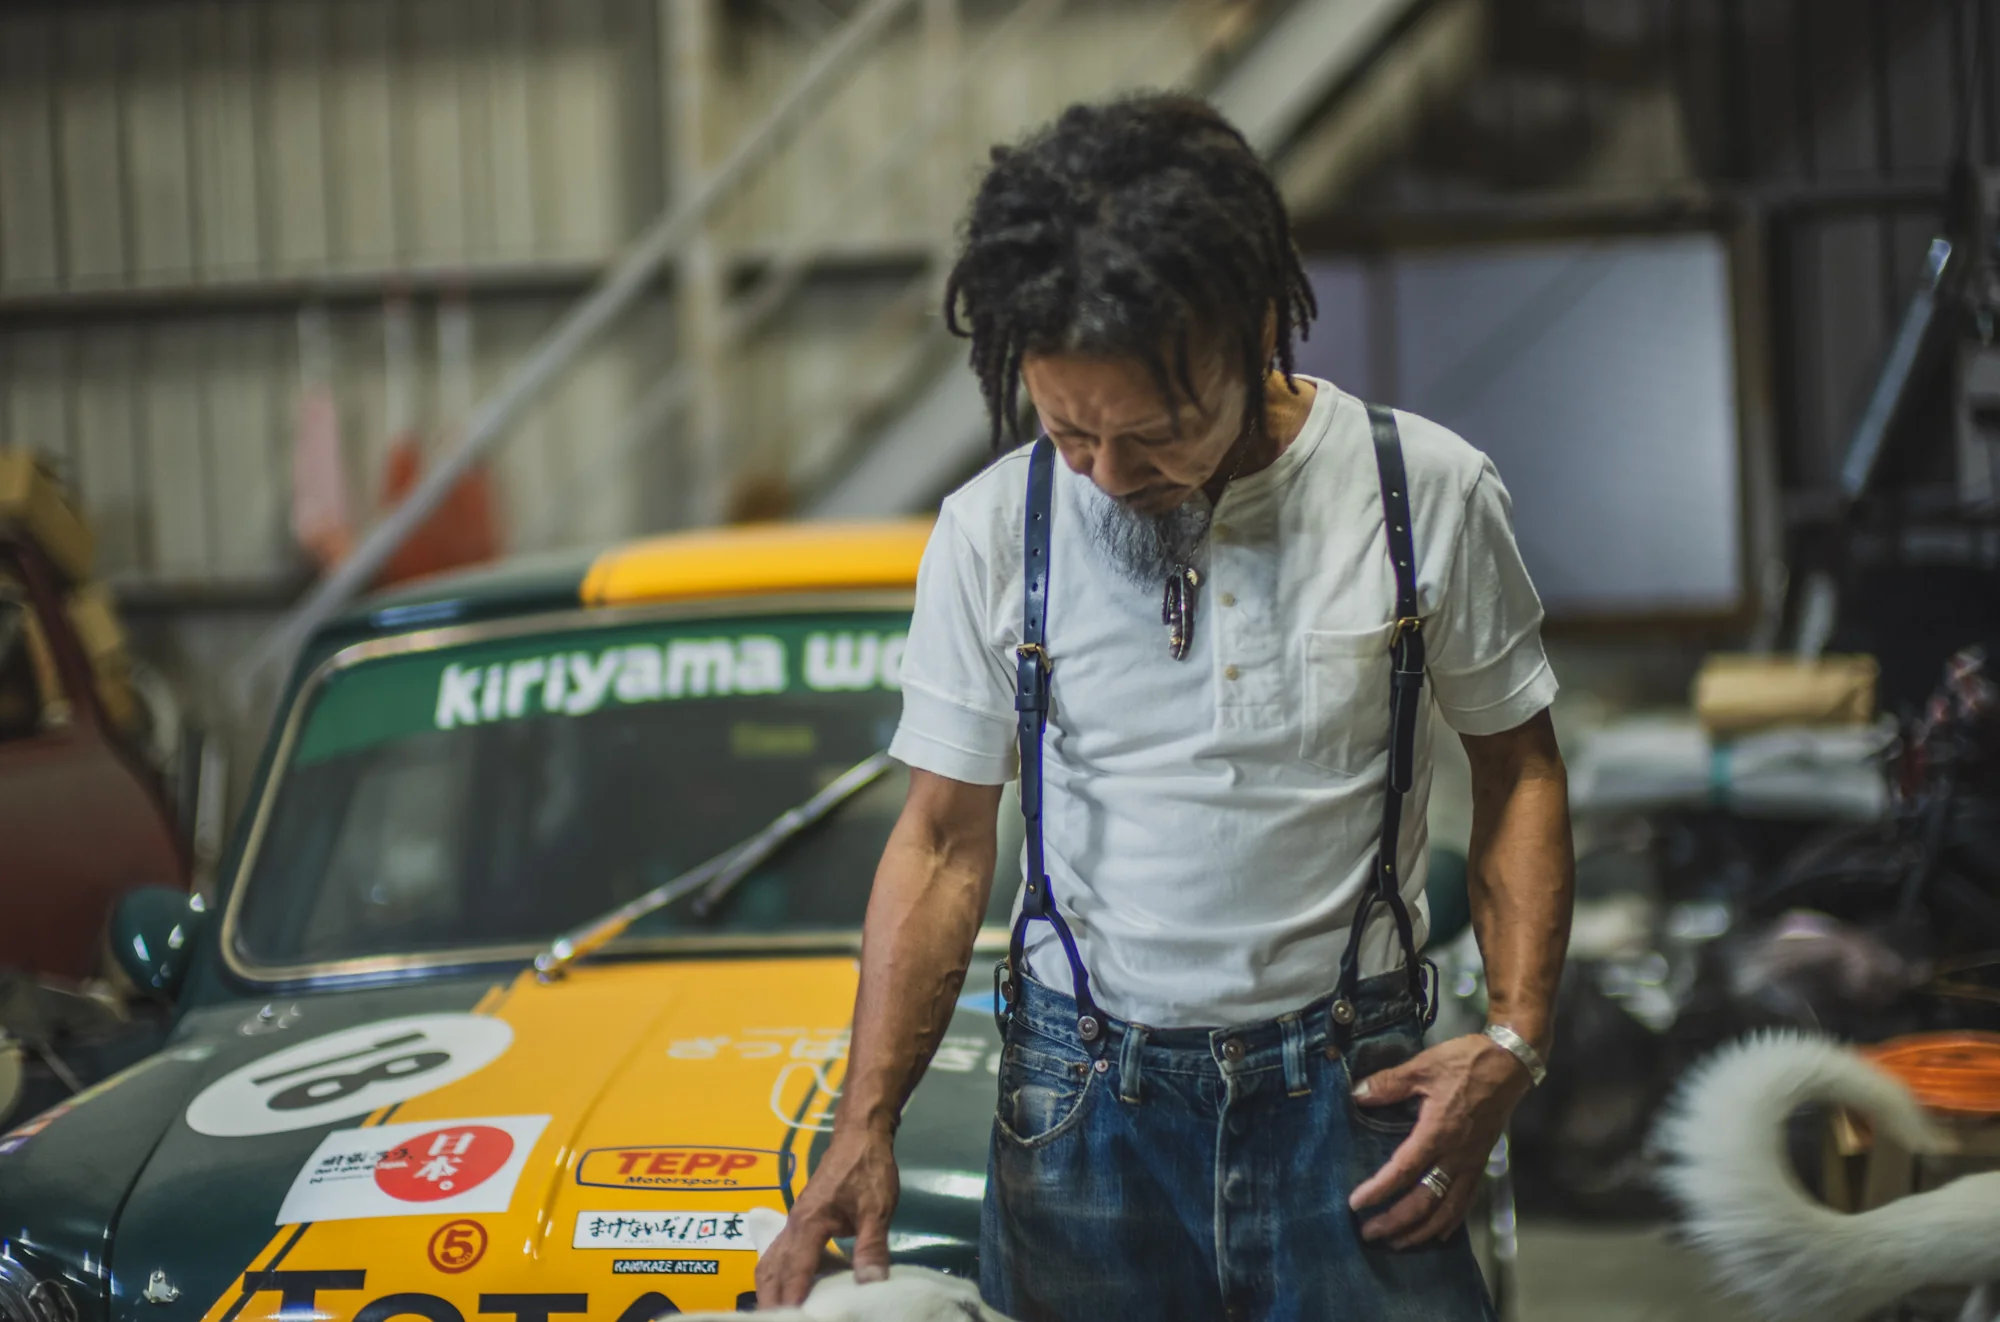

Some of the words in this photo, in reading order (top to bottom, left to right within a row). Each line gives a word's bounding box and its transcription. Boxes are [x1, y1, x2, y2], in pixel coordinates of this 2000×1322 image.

[435, 634, 788, 729] kiriyama
[251, 1031, 451, 1112] 18
[618, 1152, 759, 1177] TEPP
[624, 1176, 740, 1187] Motorsports
[613, 1260, 673, 1273] KAMIKAZE
[673, 1260, 718, 1274] ATTACK
